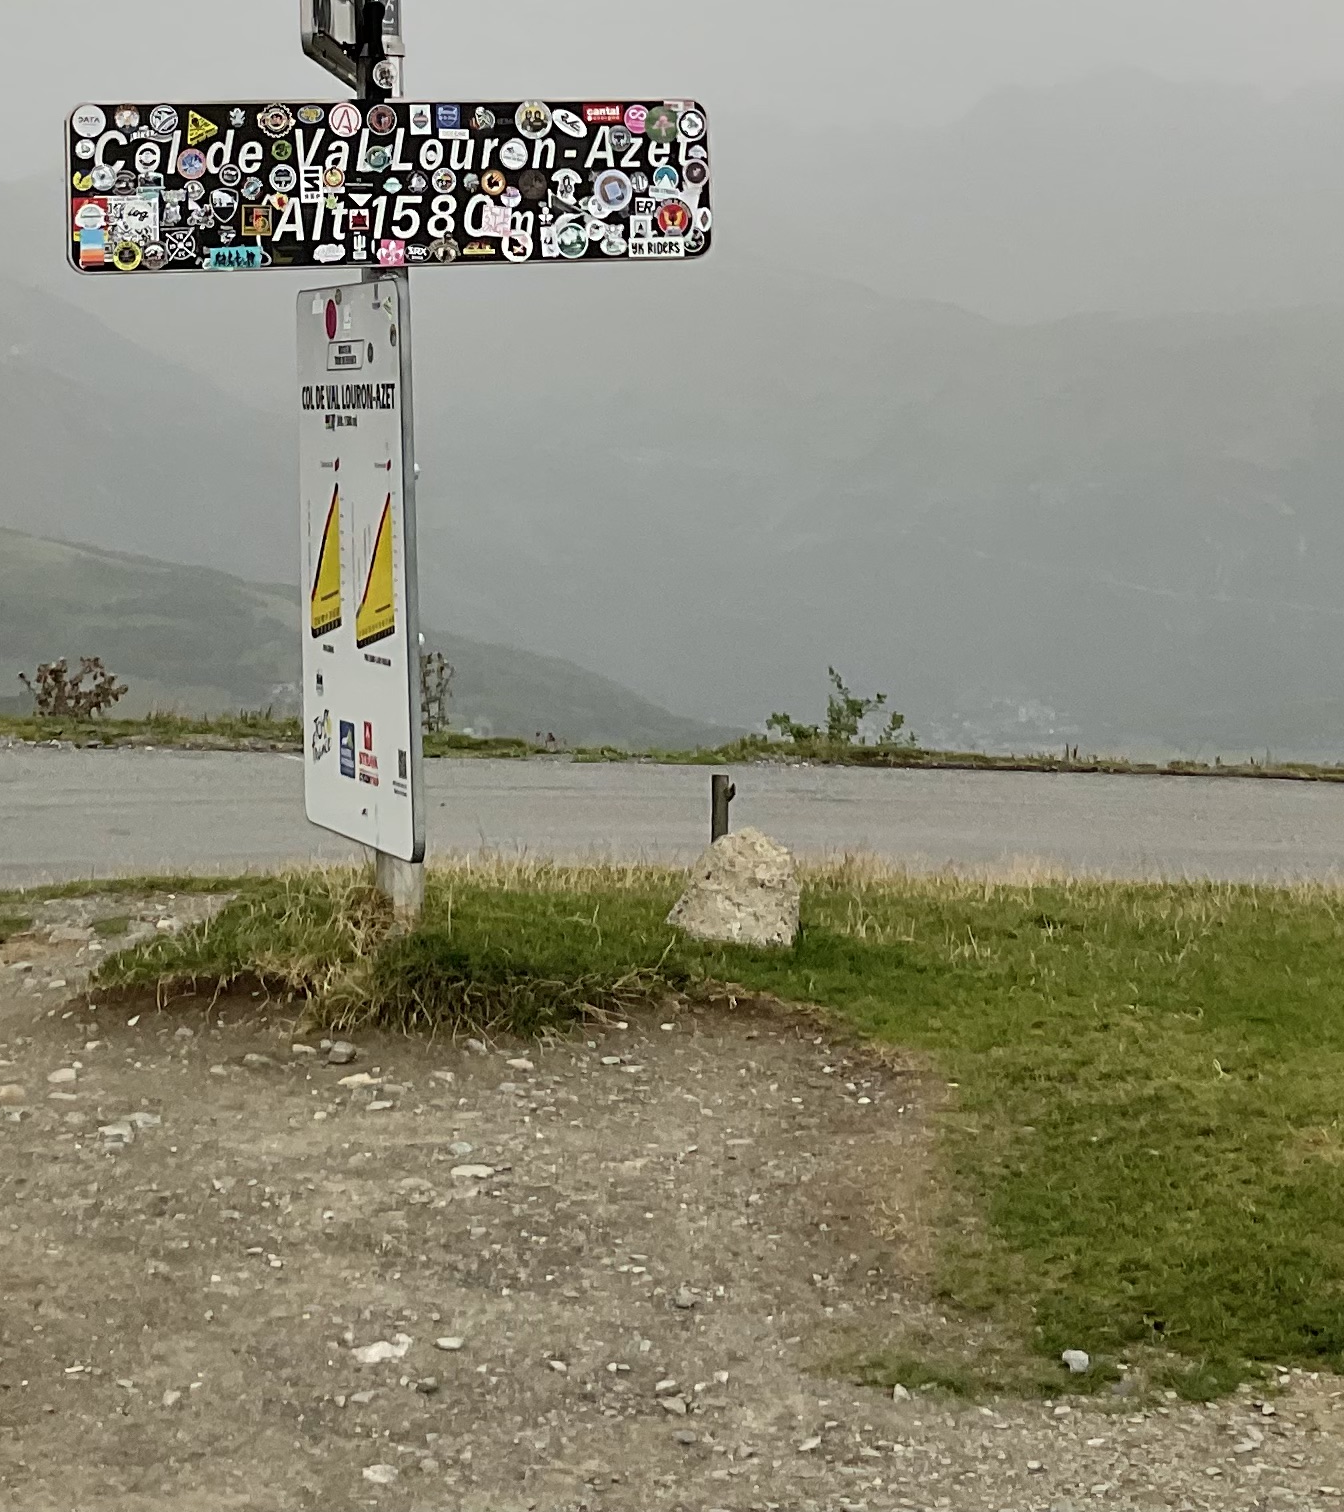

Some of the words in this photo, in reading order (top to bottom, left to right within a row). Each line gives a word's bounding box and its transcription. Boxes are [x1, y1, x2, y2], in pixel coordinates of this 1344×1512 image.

[94, 128, 181, 175] Col
[206, 129, 264, 174] de
[636, 201, 654, 214] ER
[301, 386, 315, 411] COL
[315, 385, 325, 410] DE
[325, 384, 341, 410] VAL
[341, 383, 396, 410] LOURON-AZET
